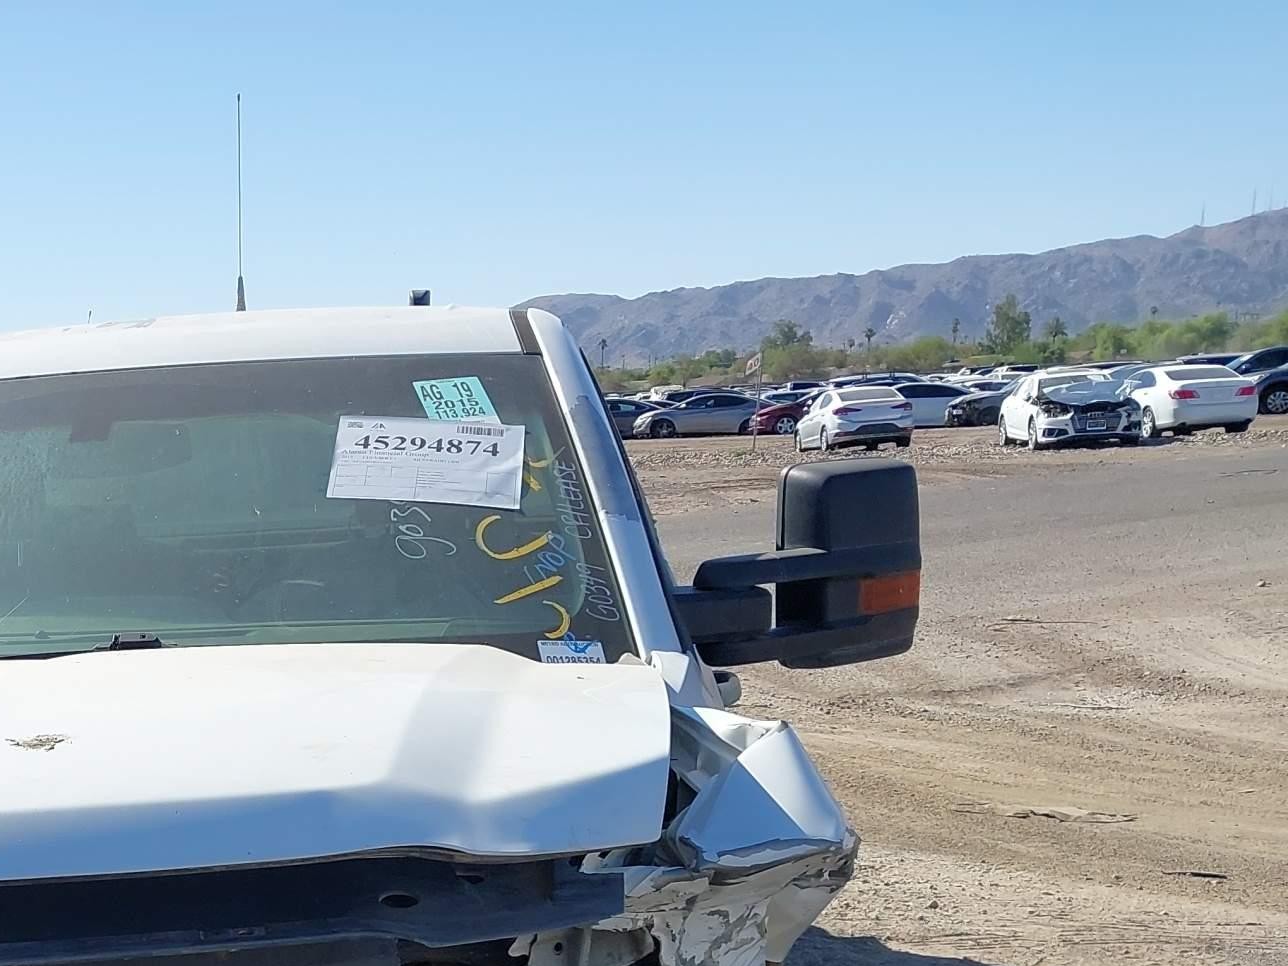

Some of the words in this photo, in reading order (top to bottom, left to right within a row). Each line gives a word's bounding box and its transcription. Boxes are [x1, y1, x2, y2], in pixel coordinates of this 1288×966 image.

[420, 382, 443, 402] AG
[452, 381, 473, 398] 19
[432, 398, 479, 410] 2015
[354, 435, 499, 456] 45294874
